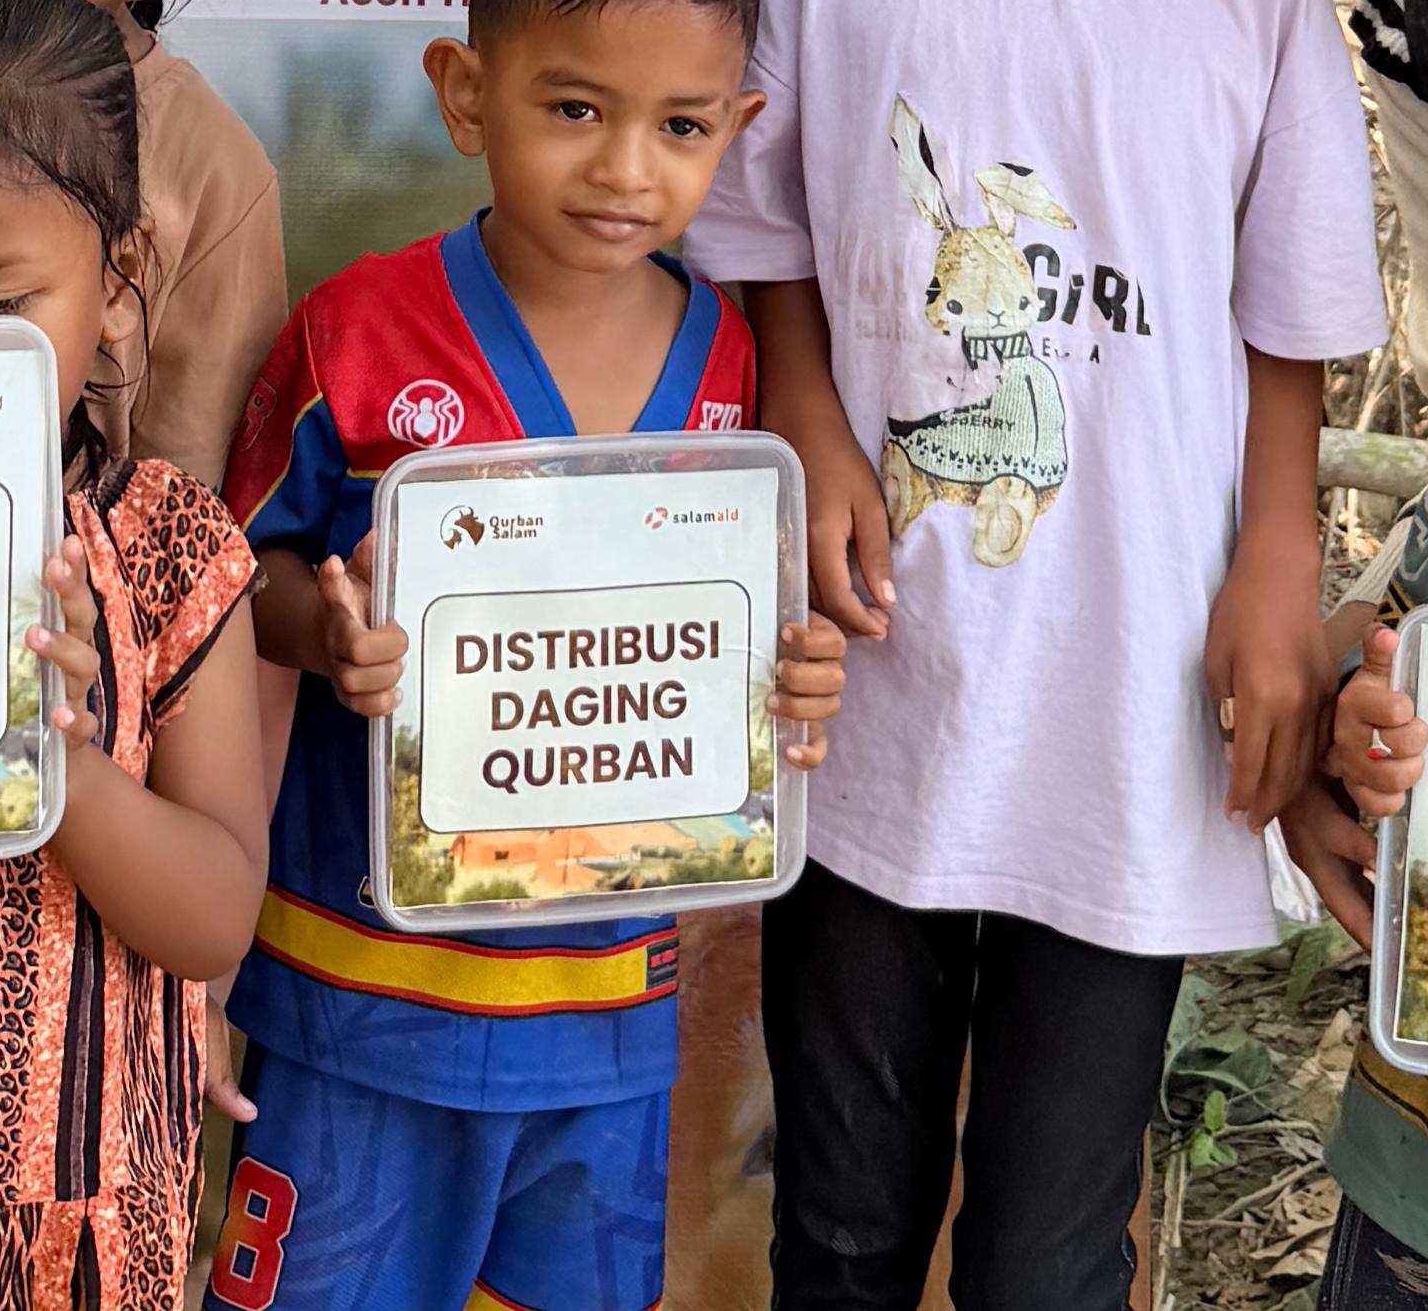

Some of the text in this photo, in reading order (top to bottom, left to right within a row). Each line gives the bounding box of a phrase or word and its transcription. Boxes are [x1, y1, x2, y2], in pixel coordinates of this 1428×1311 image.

[699, 400, 743, 431] SPID
[489, 514, 544, 528] Qurban
[673, 508, 739, 524] salamaid
[492, 526, 537, 539] Salam
[455, 620, 720, 675] DISTRIBUSI
[491, 680, 687, 732] DAGING
[482, 737, 693, 795] QURBAN
